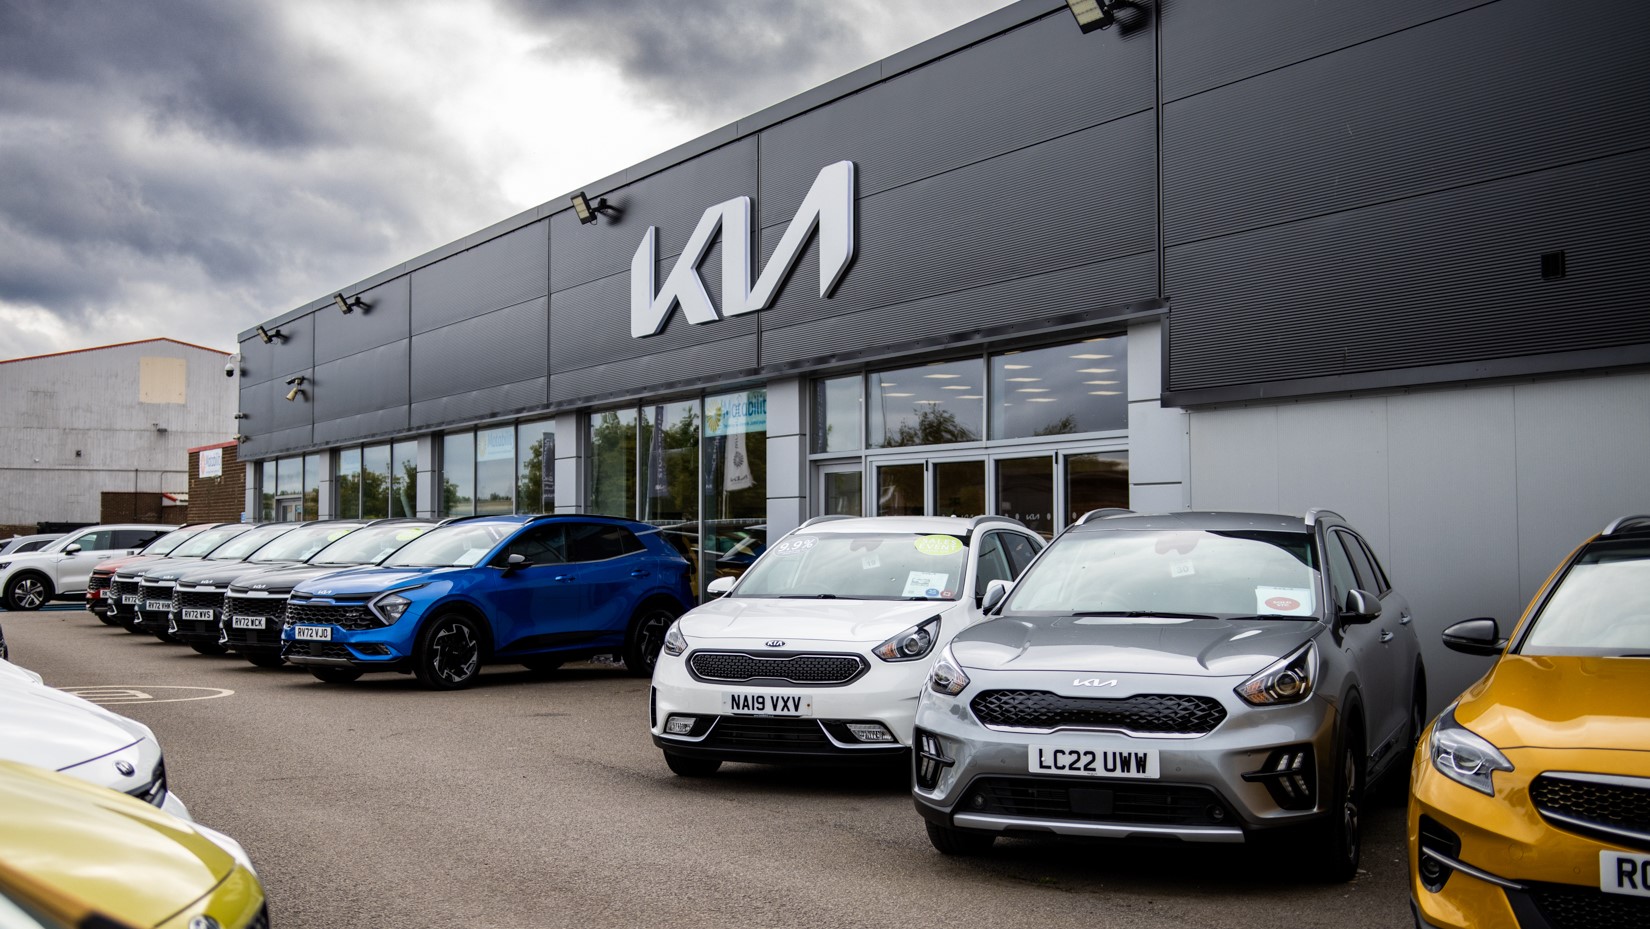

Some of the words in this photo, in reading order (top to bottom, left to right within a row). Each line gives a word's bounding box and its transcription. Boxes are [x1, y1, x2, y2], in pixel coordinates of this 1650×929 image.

[184, 611, 198, 619] RV72
[234, 618, 249, 627] RV72
[297, 628, 313, 638] RV72
[731, 694, 765, 711] NA19
[771, 695, 801, 712] VXV
[1038, 748, 1096, 772] LC22
[1103, 751, 1148, 773] UWW
